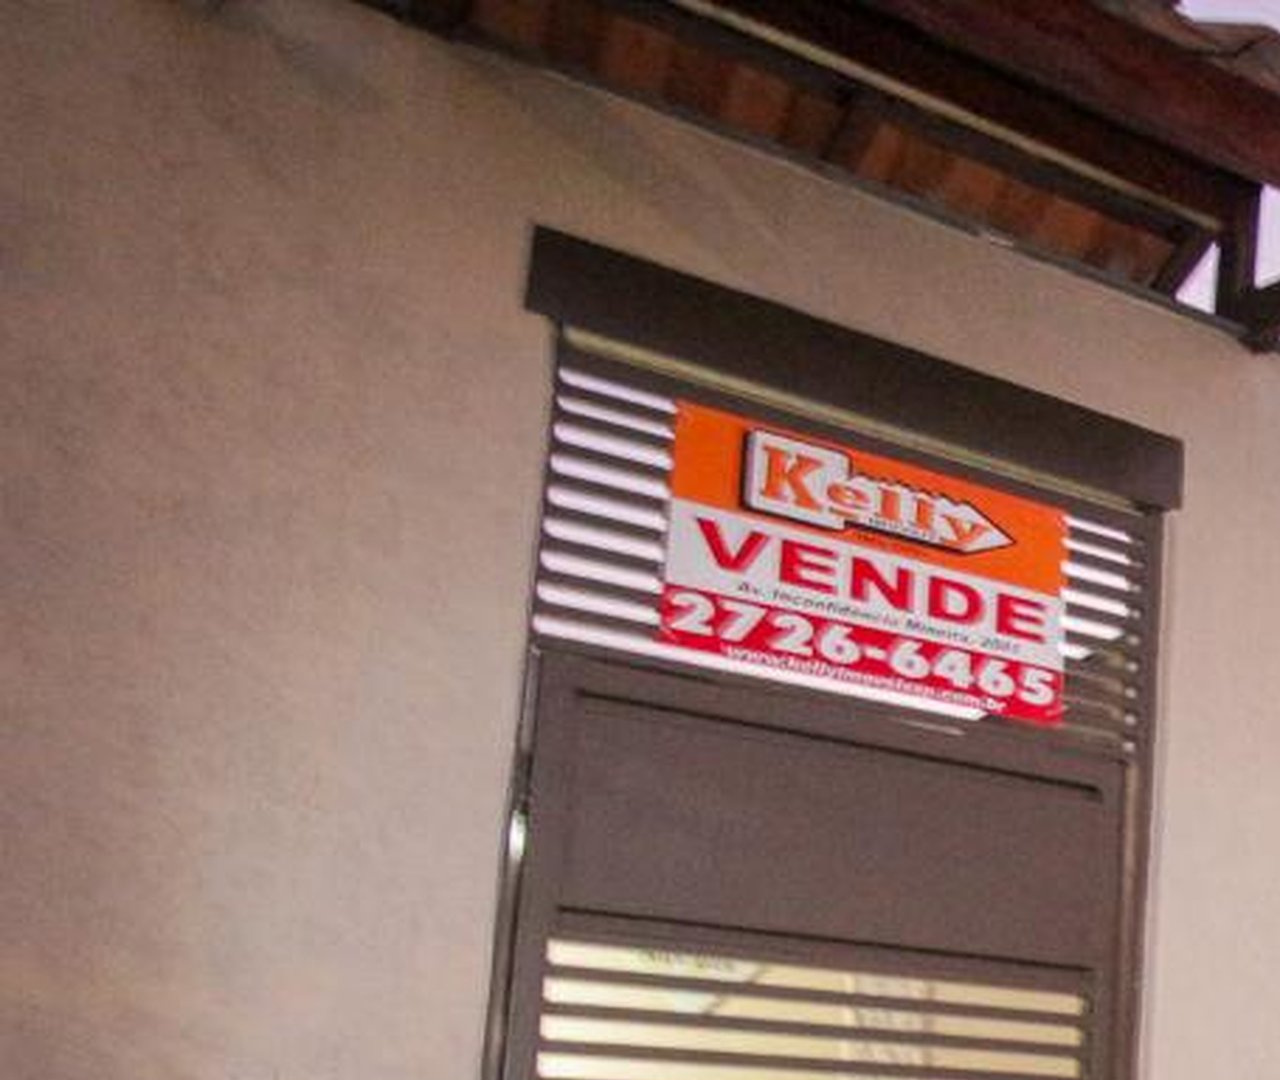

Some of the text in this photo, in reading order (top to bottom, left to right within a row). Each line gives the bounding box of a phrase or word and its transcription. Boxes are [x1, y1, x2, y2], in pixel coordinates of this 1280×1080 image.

[761, 444, 989, 548] Kelly
[697, 517, 1046, 643] VENDE
[668, 590, 1055, 706] 2726-6465
